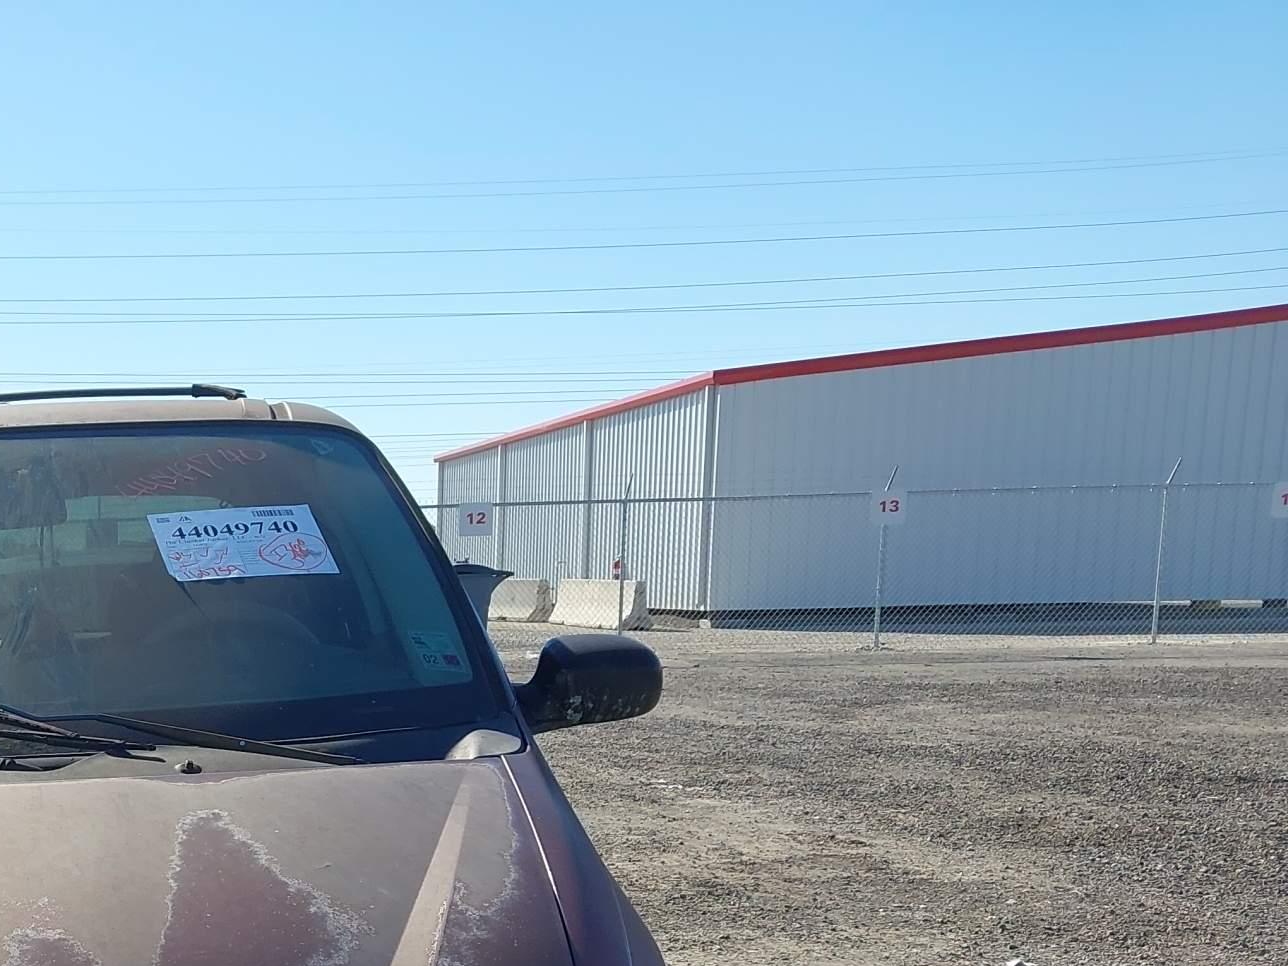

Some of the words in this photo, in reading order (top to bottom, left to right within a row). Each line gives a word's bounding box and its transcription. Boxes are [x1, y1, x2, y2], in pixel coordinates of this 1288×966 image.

[1281, 493, 1288, 506] 1
[879, 500, 900, 513] 13
[466, 511, 487, 525] 12
[172, 520, 299, 540] 44049740
